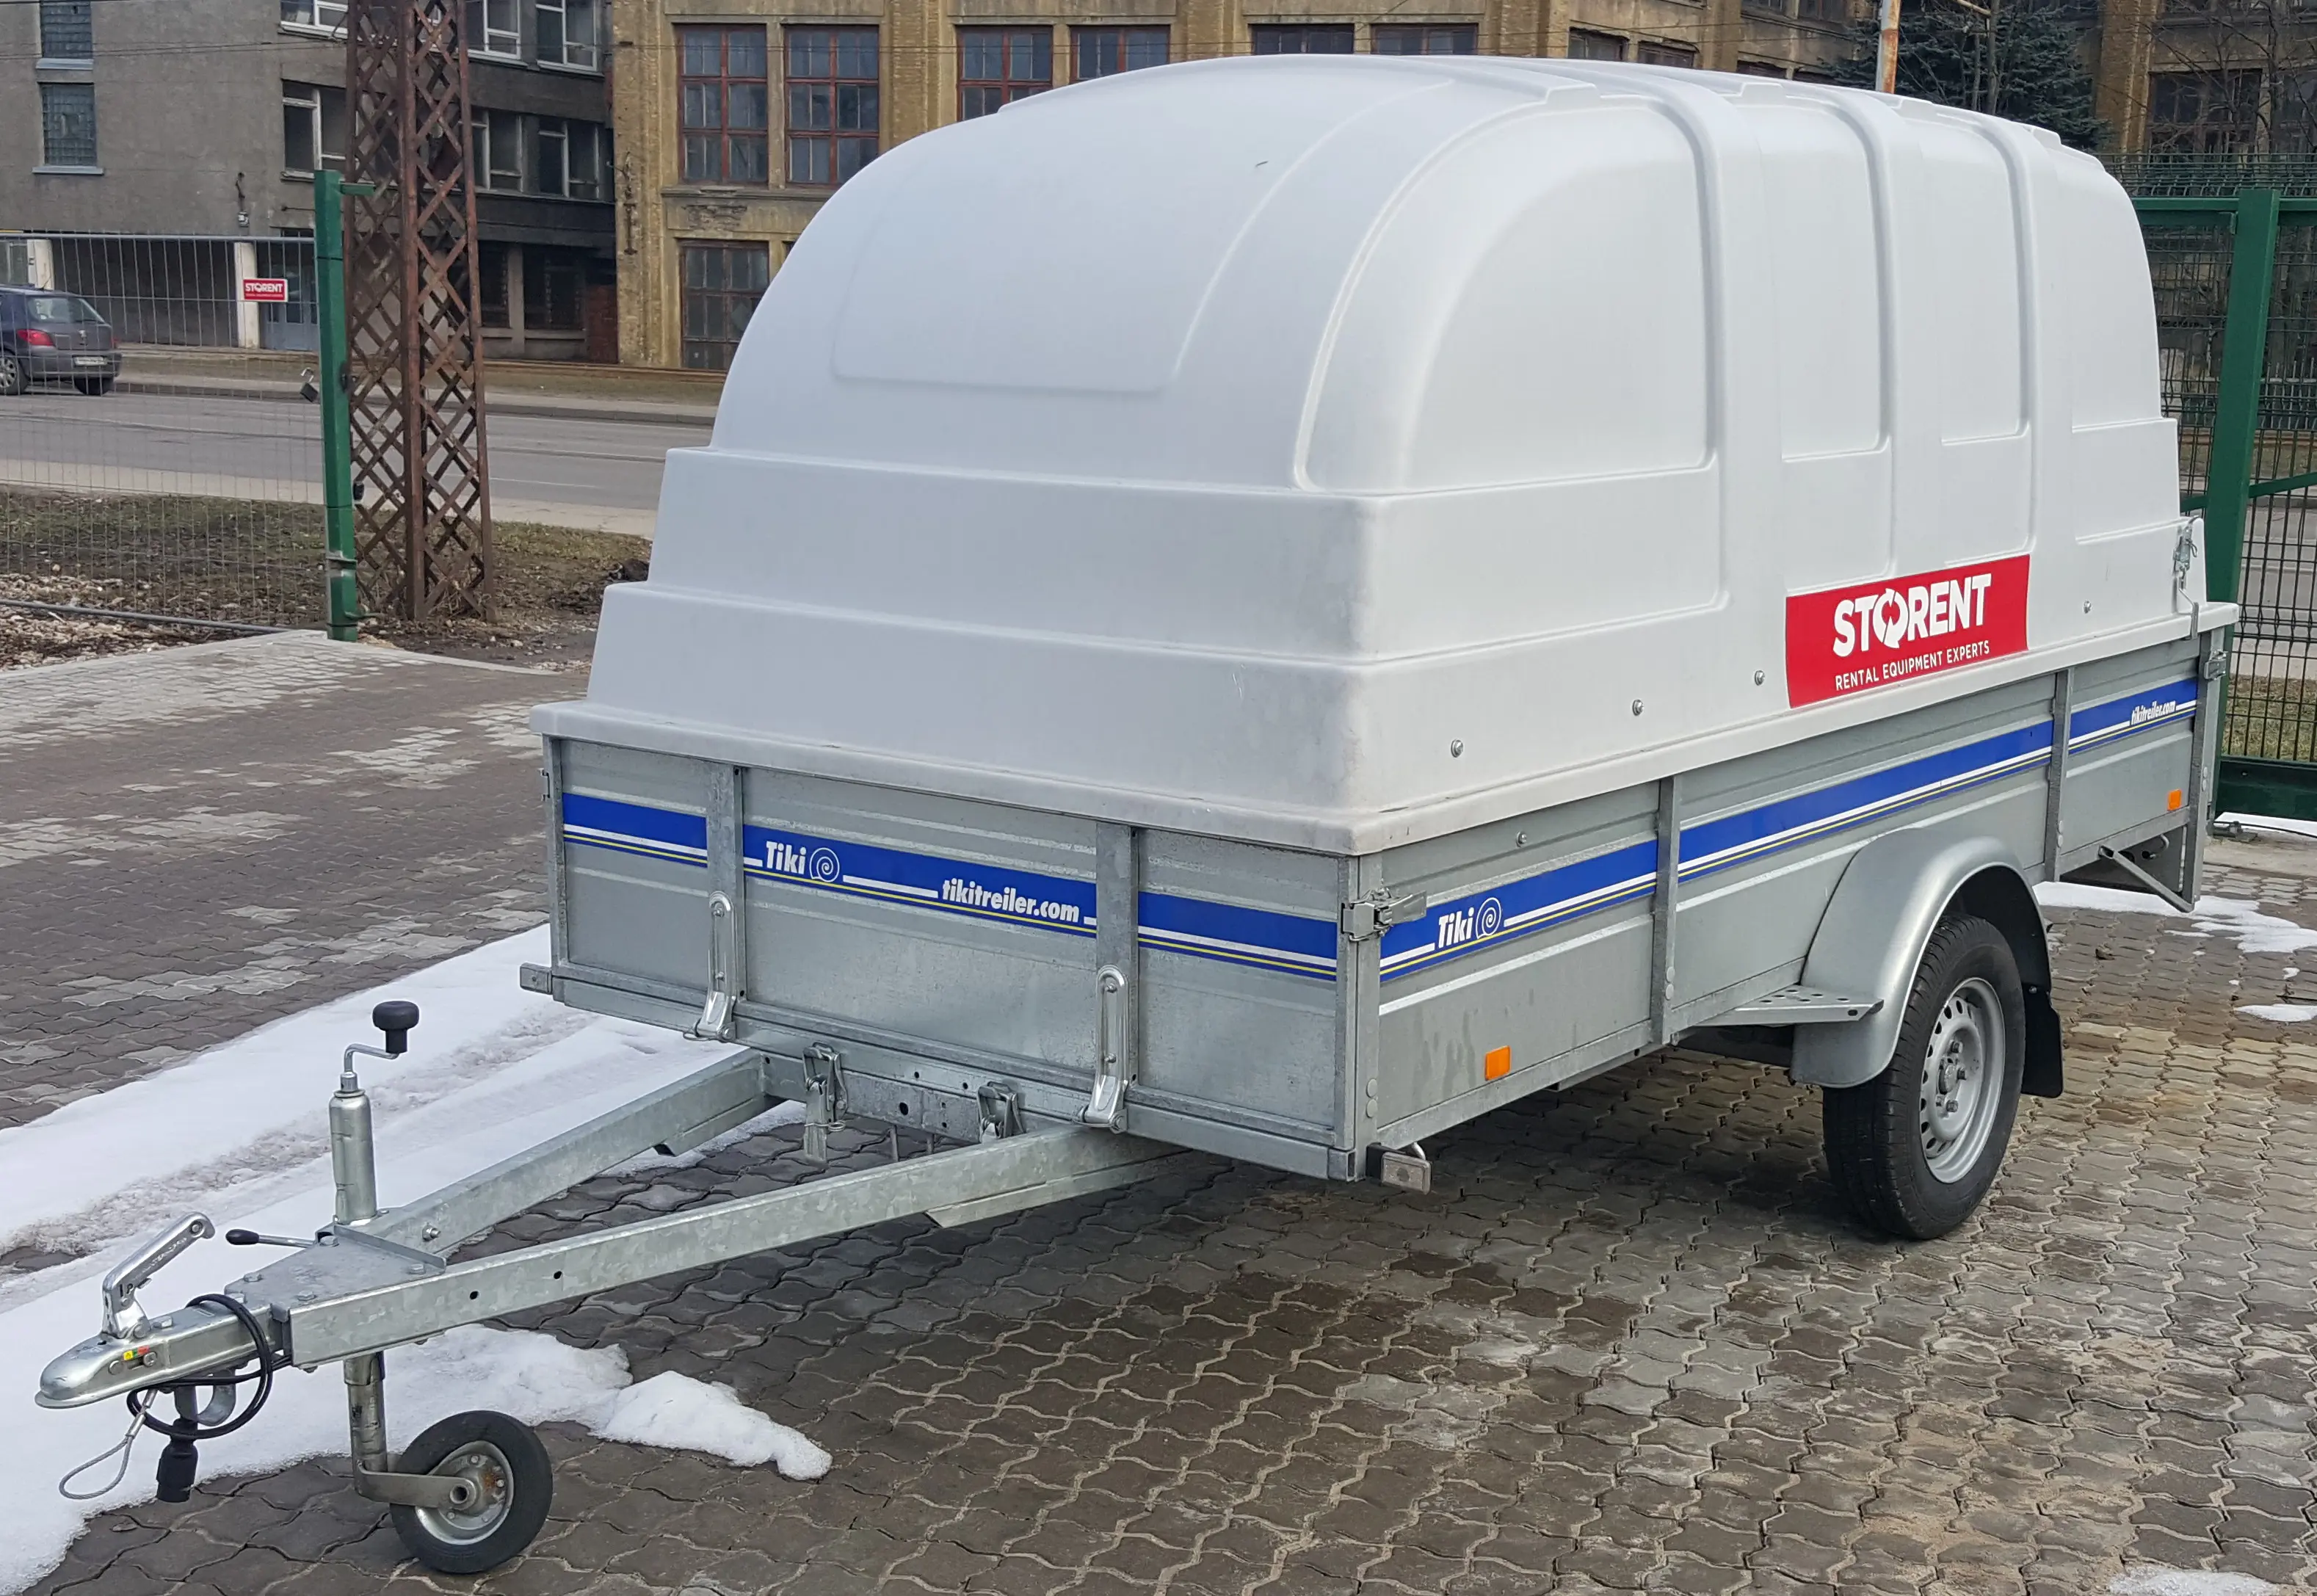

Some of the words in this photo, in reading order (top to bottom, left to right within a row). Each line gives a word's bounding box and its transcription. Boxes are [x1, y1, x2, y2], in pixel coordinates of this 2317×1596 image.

[245, 283, 283, 292] STORENT
[1832, 573, 1992, 657] STORENT
[1835, 667, 1879, 691] RENTAL
[1882, 650, 1943, 679] EQUIPMENT
[1946, 640, 1990, 664] EXPERTS
[2131, 700, 2176, 725] tikitreiler.com
[765, 841, 806, 876] Tiki
[942, 878, 1080, 924] tikitreiler.com
[1438, 907, 1474, 948] Tiki
